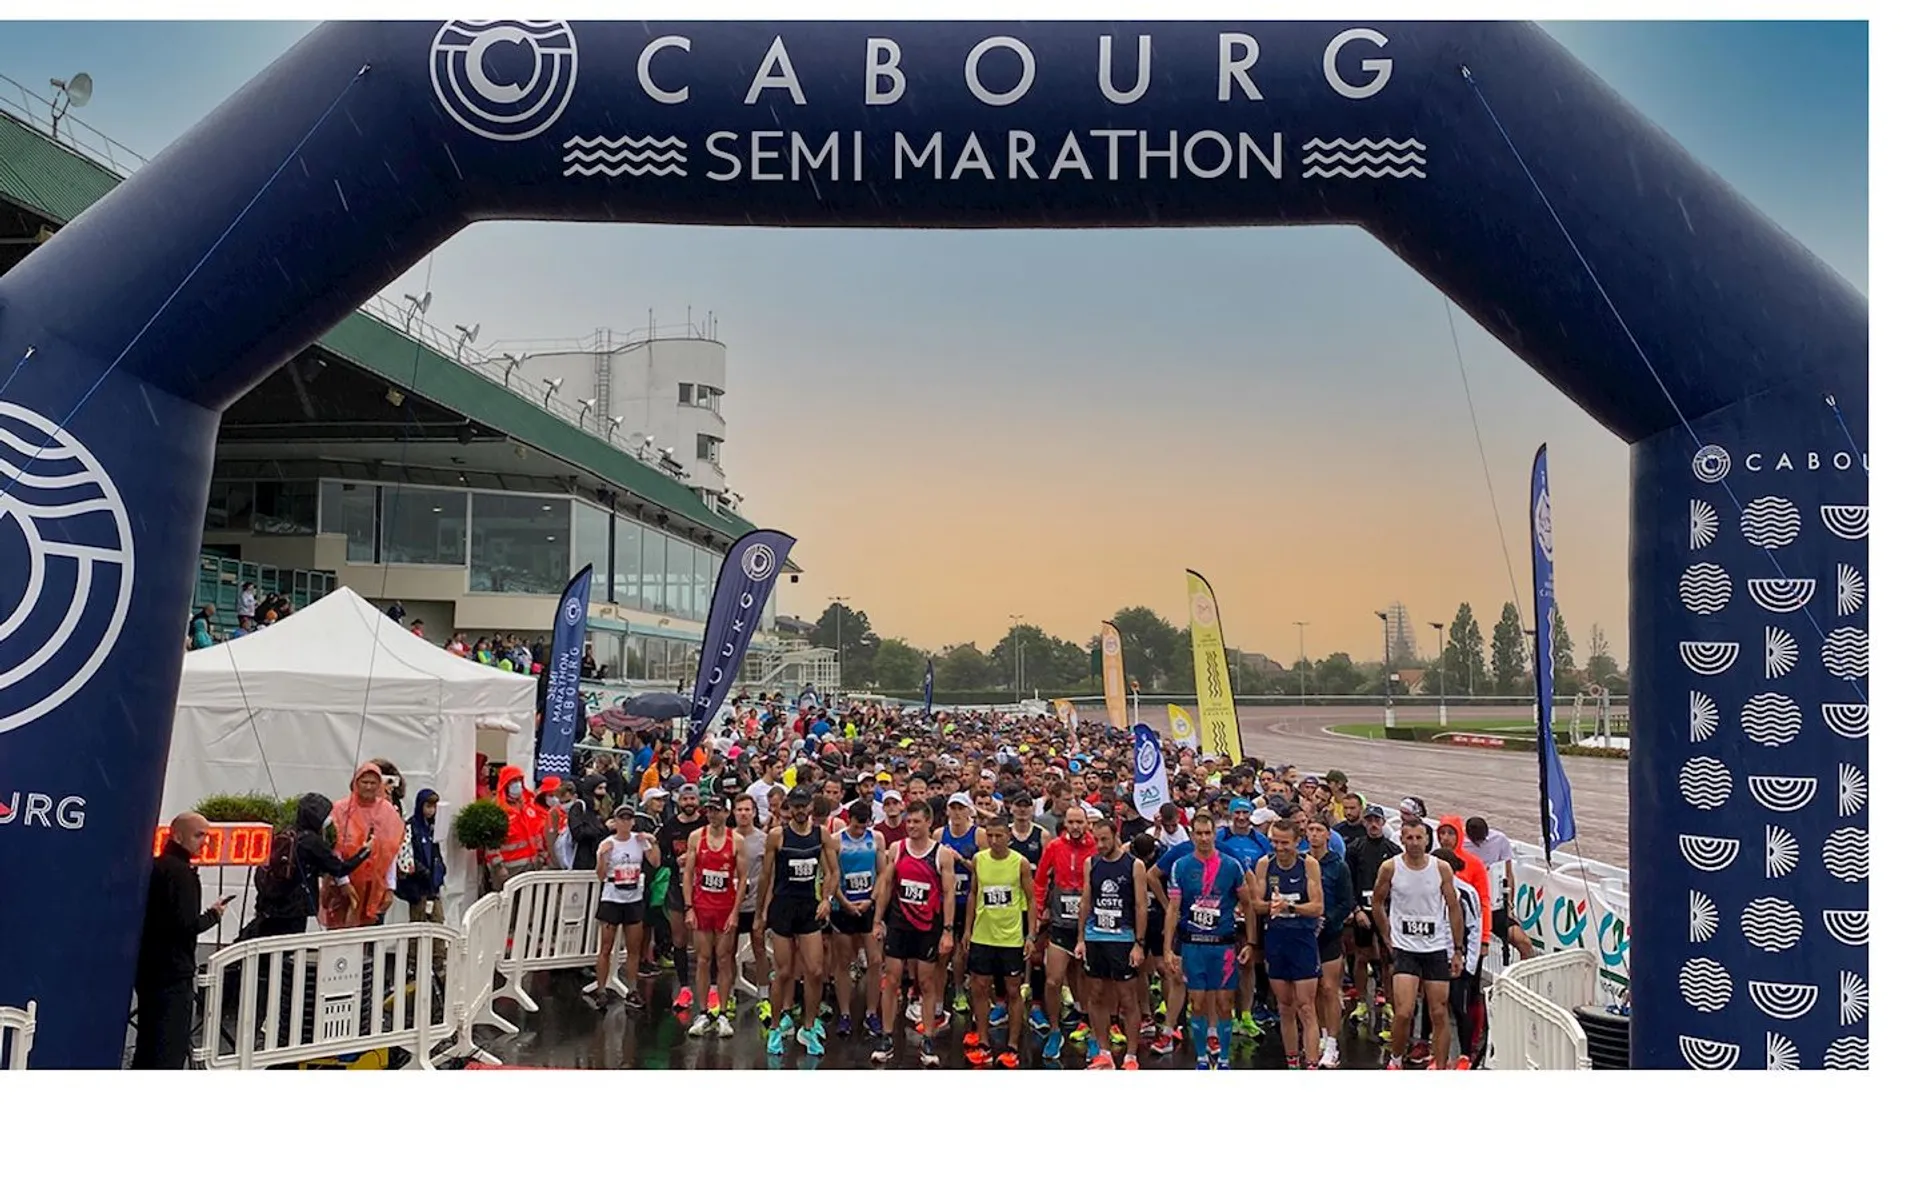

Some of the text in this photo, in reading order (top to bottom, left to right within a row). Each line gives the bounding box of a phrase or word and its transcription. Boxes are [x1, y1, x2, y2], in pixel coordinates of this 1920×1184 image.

[636, 28, 1394, 106] CABOURG
[705, 130, 1283, 181] SEMI MARATHON
[552, 652, 570, 723] MARATHON
[561, 646, 580, 735] CABOURG
[685, 591, 753, 742] ABOURG
[1406, 920, 1430, 934] 1944
